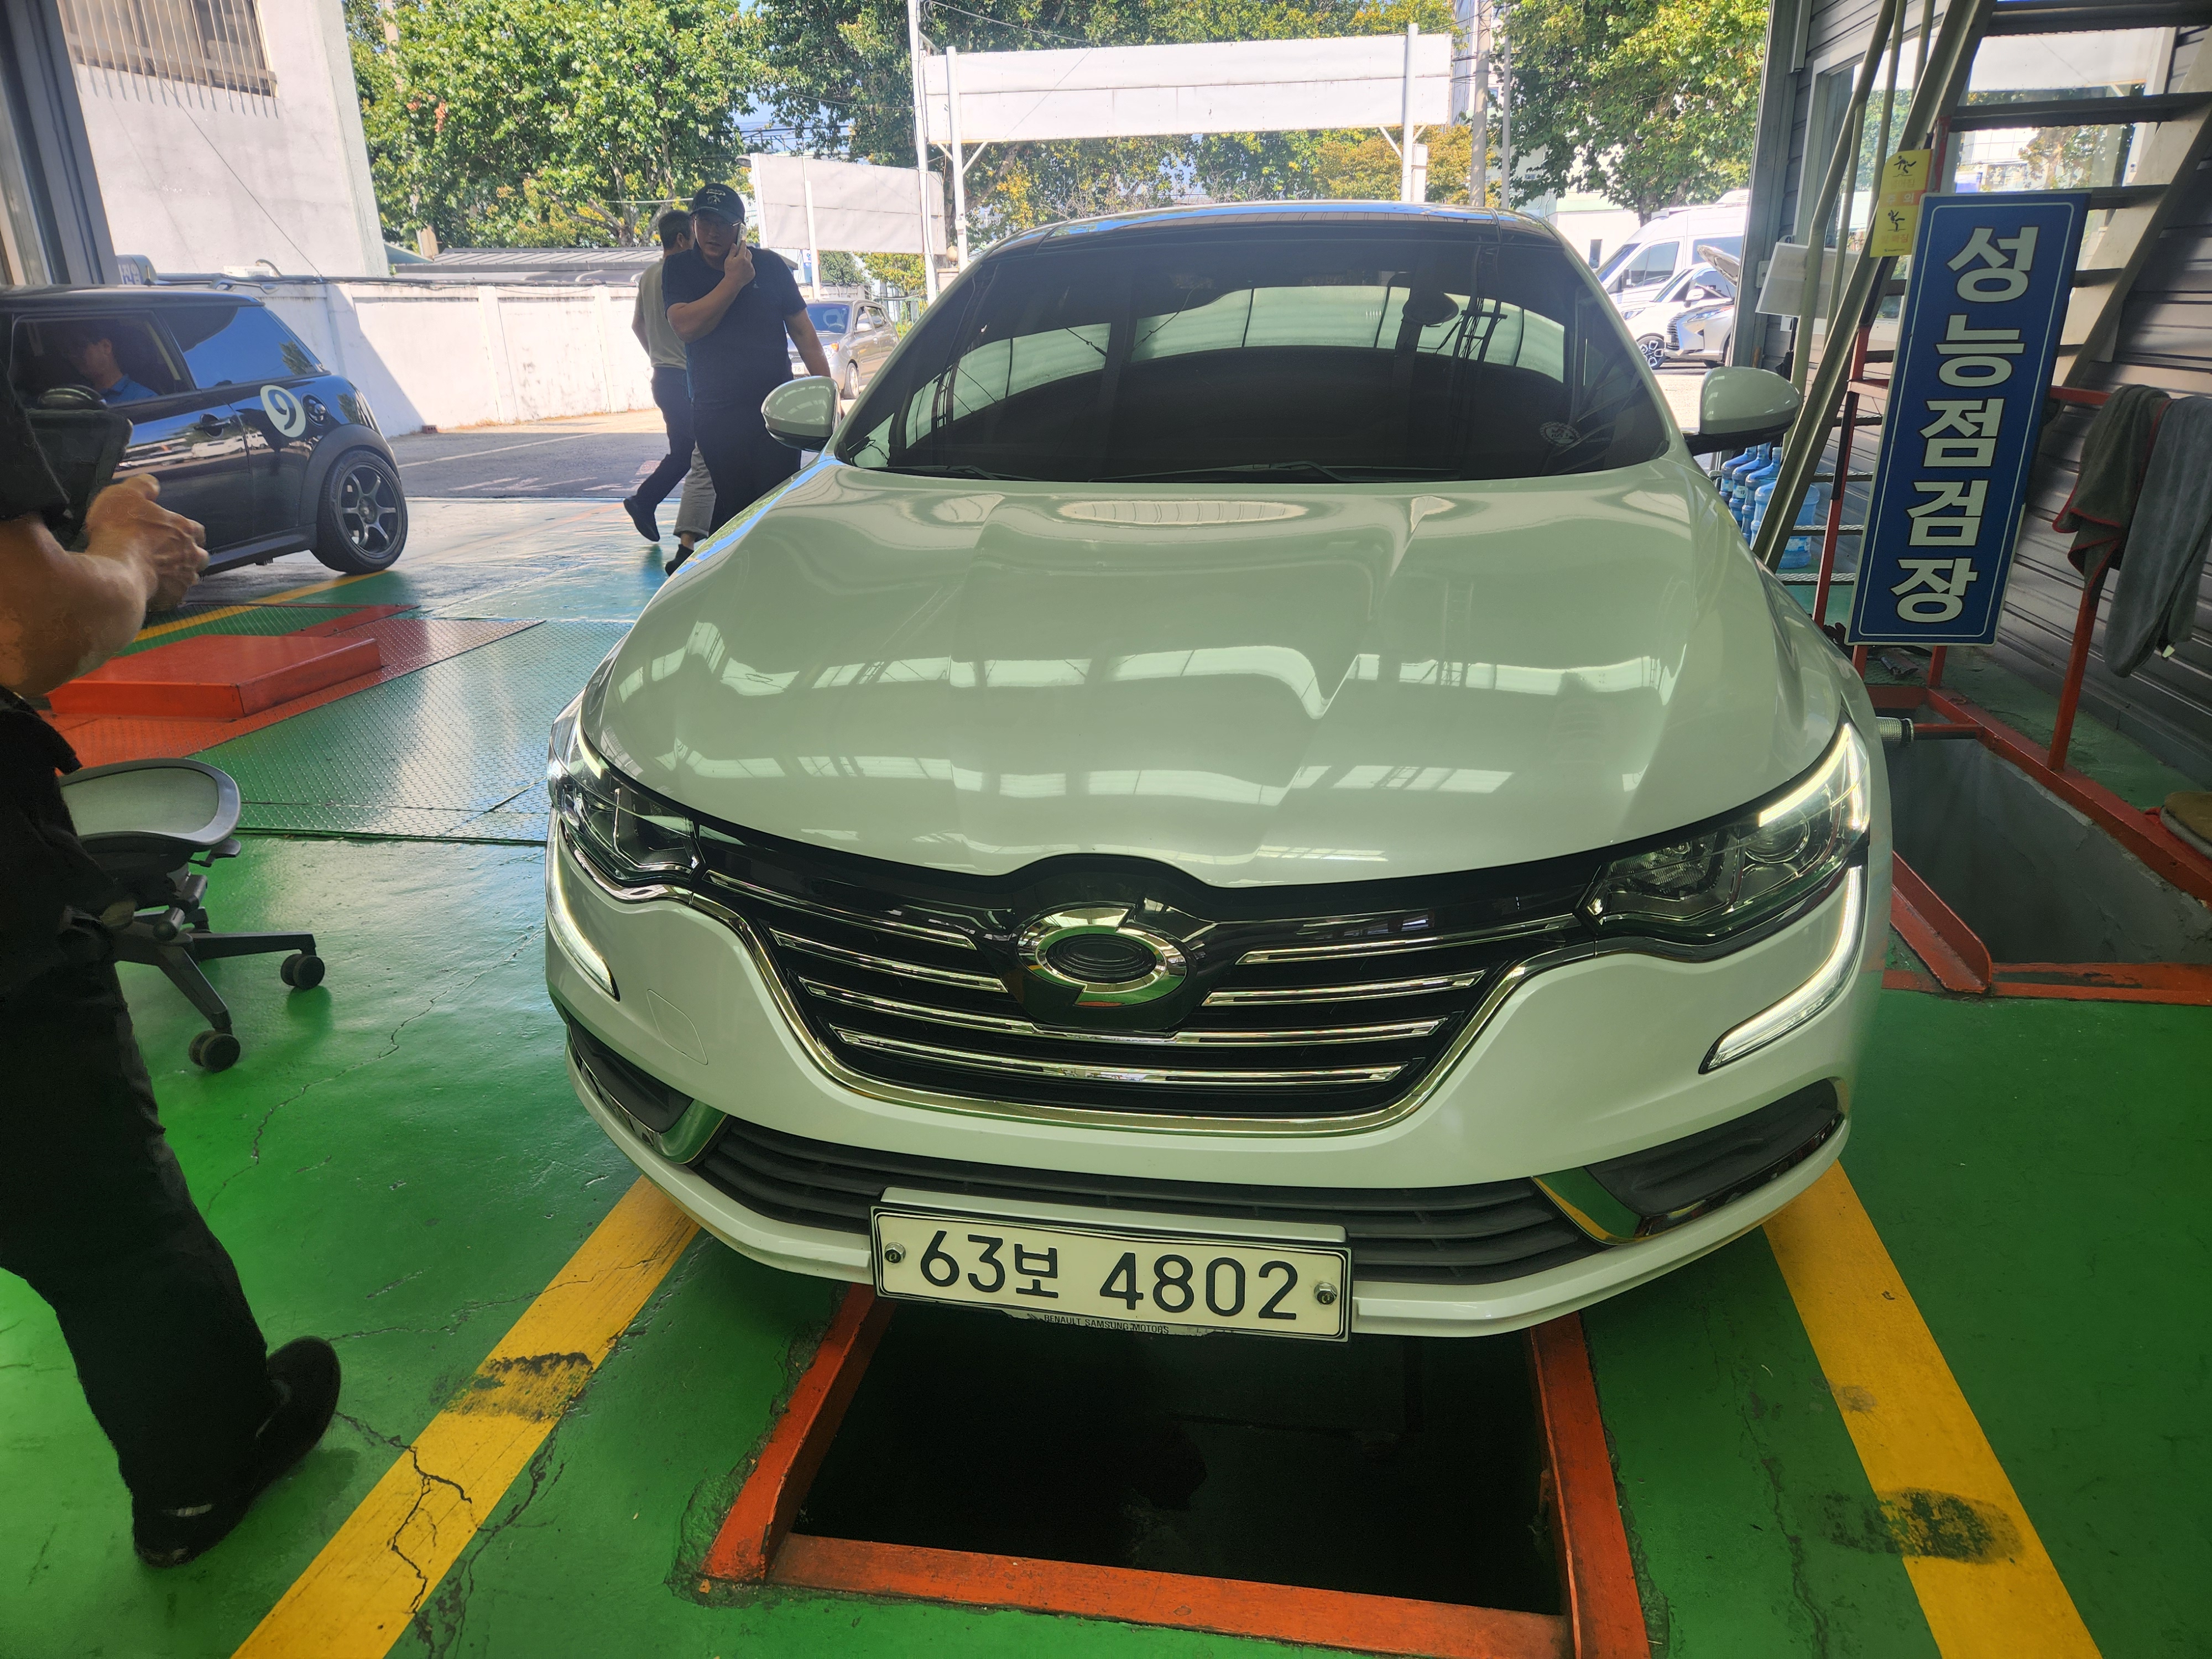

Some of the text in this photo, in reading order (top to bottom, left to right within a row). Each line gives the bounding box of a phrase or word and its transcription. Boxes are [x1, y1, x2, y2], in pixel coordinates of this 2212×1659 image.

[268, 389, 296, 430] 9
[1891, 226, 2036, 624] 성능점검장
[920, 1230, 1298, 1321] 63보 4802
[1044, 1314, 1170, 1334] RENAULT SAMSUNG MOTORS
